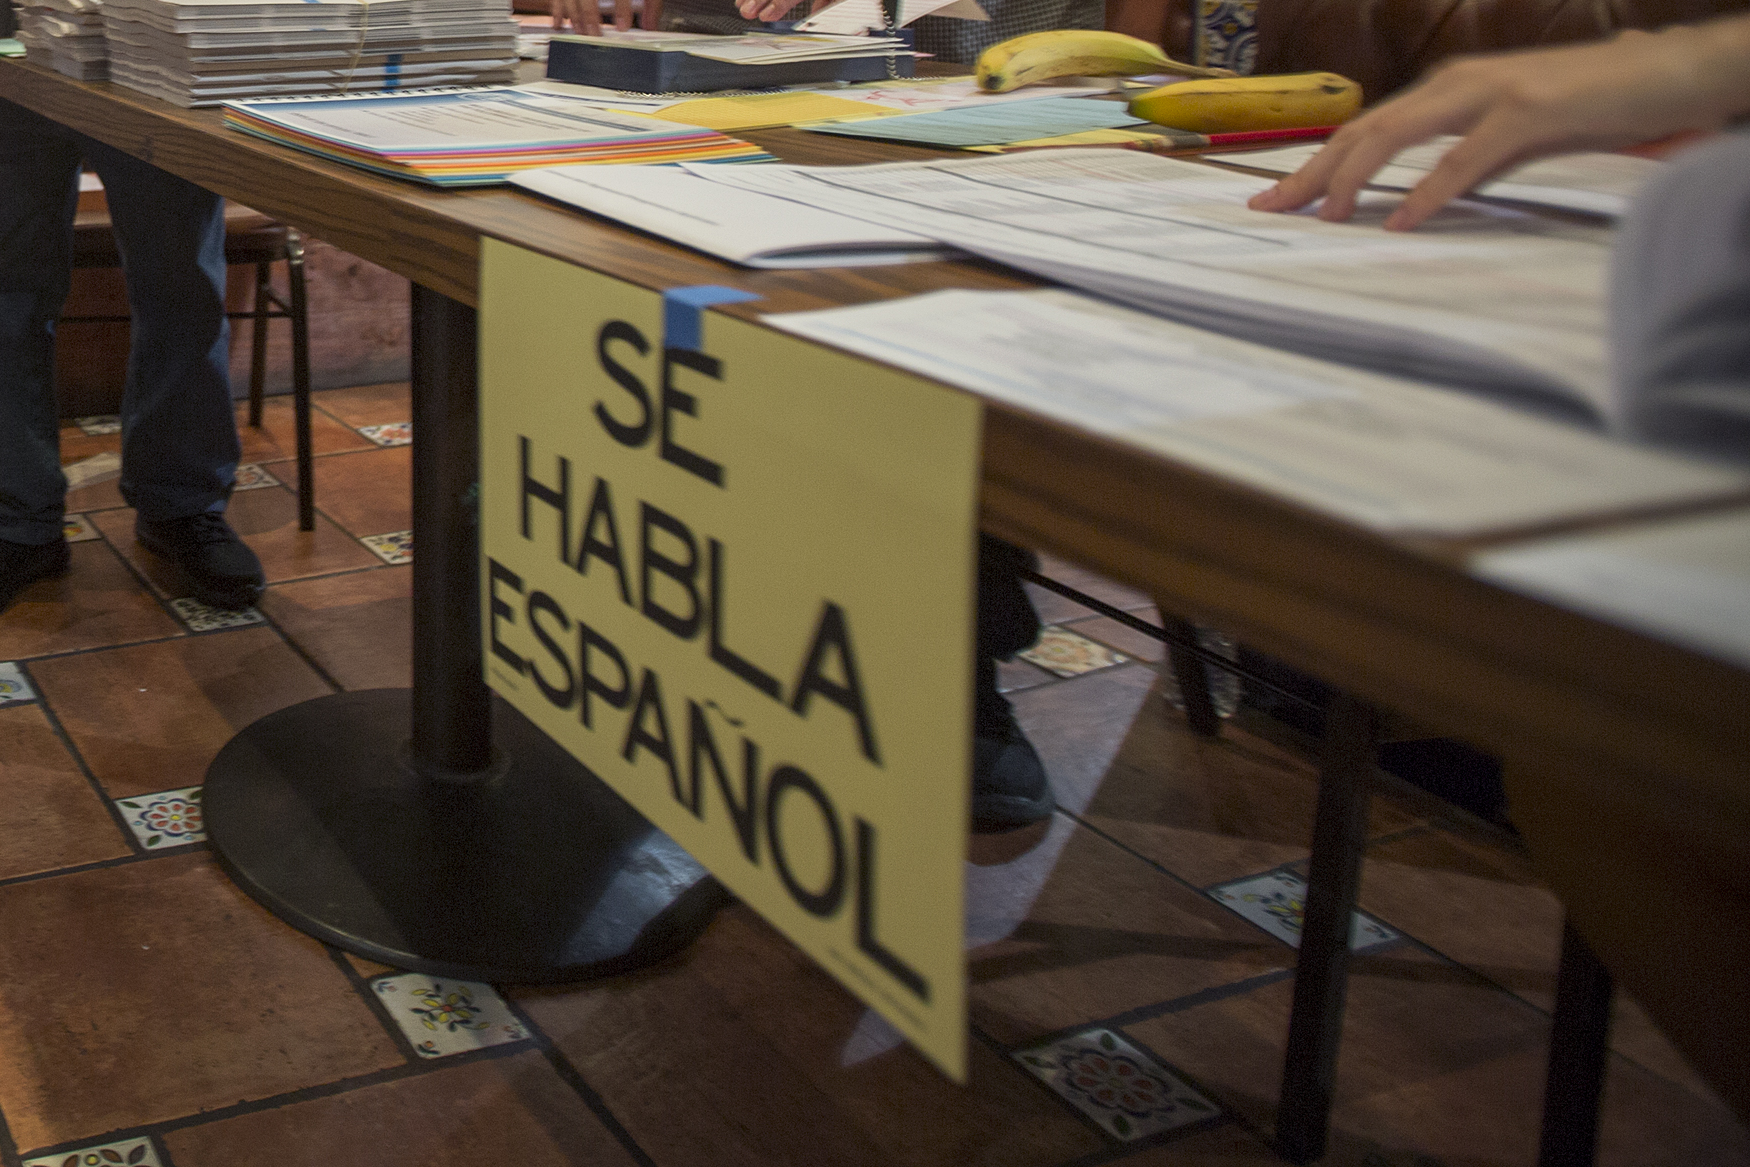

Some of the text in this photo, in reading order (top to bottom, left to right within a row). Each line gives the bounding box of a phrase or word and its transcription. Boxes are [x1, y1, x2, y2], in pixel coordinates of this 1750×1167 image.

[592, 320, 726, 490] SE
[519, 434, 885, 769] HABLA
[487, 555, 930, 1004] ESPAÑOL
